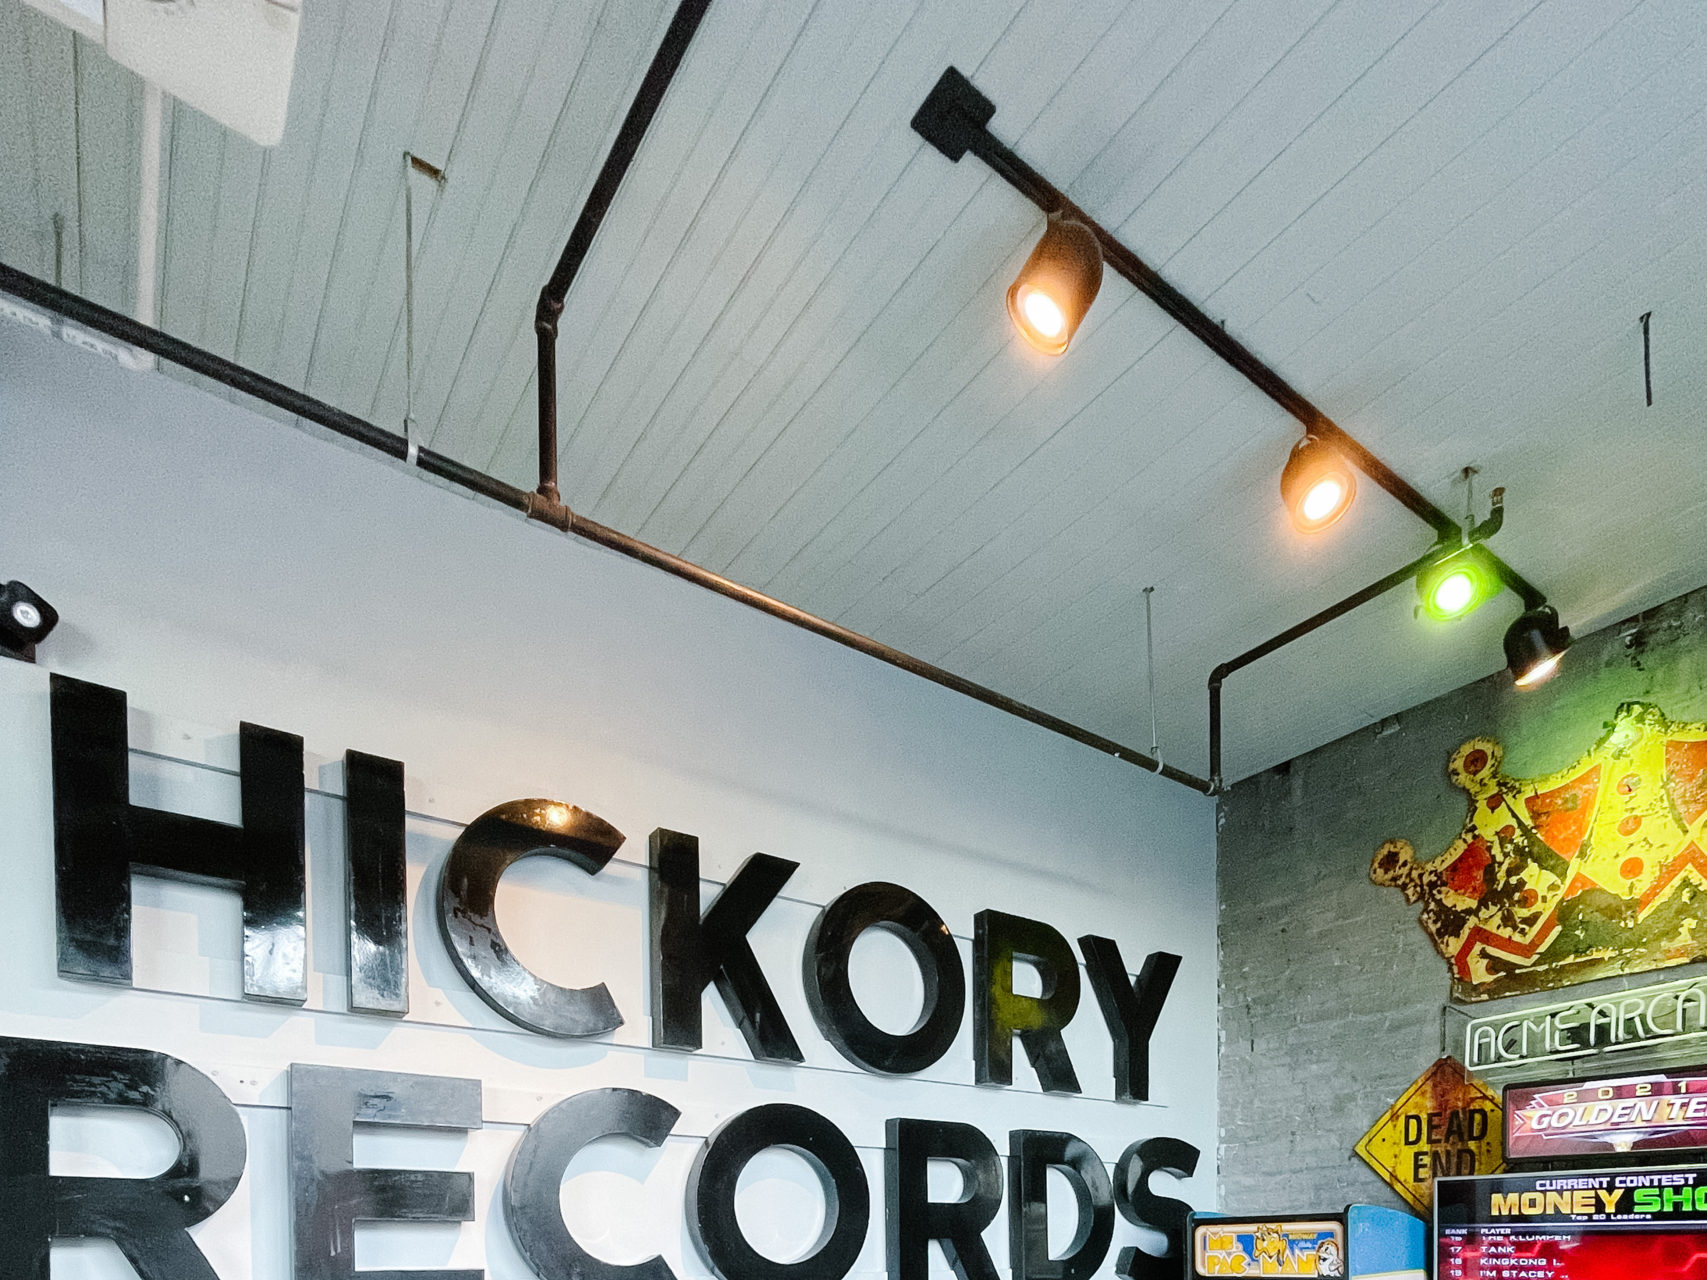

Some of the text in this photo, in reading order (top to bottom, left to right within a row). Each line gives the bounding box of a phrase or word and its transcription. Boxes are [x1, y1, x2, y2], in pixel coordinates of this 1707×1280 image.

[50, 672, 1182, 1102] HICKORY
[1473, 988, 1706, 1063] ACME ARCA
[1563, 1081, 1687, 1104] 2021
[1403, 1107, 1488, 1146] DEAD
[1531, 1099, 1659, 1130] GOLDEN
[1413, 1148, 1476, 1183] END
[1535, 1173, 1697, 1190] CURRENT CONTEST
[1490, 1188, 1625, 1216] MONEY
[1480, 1258, 1547, 1266] KINGKONG
[1502, 1270, 1555, 1278] STACEY
